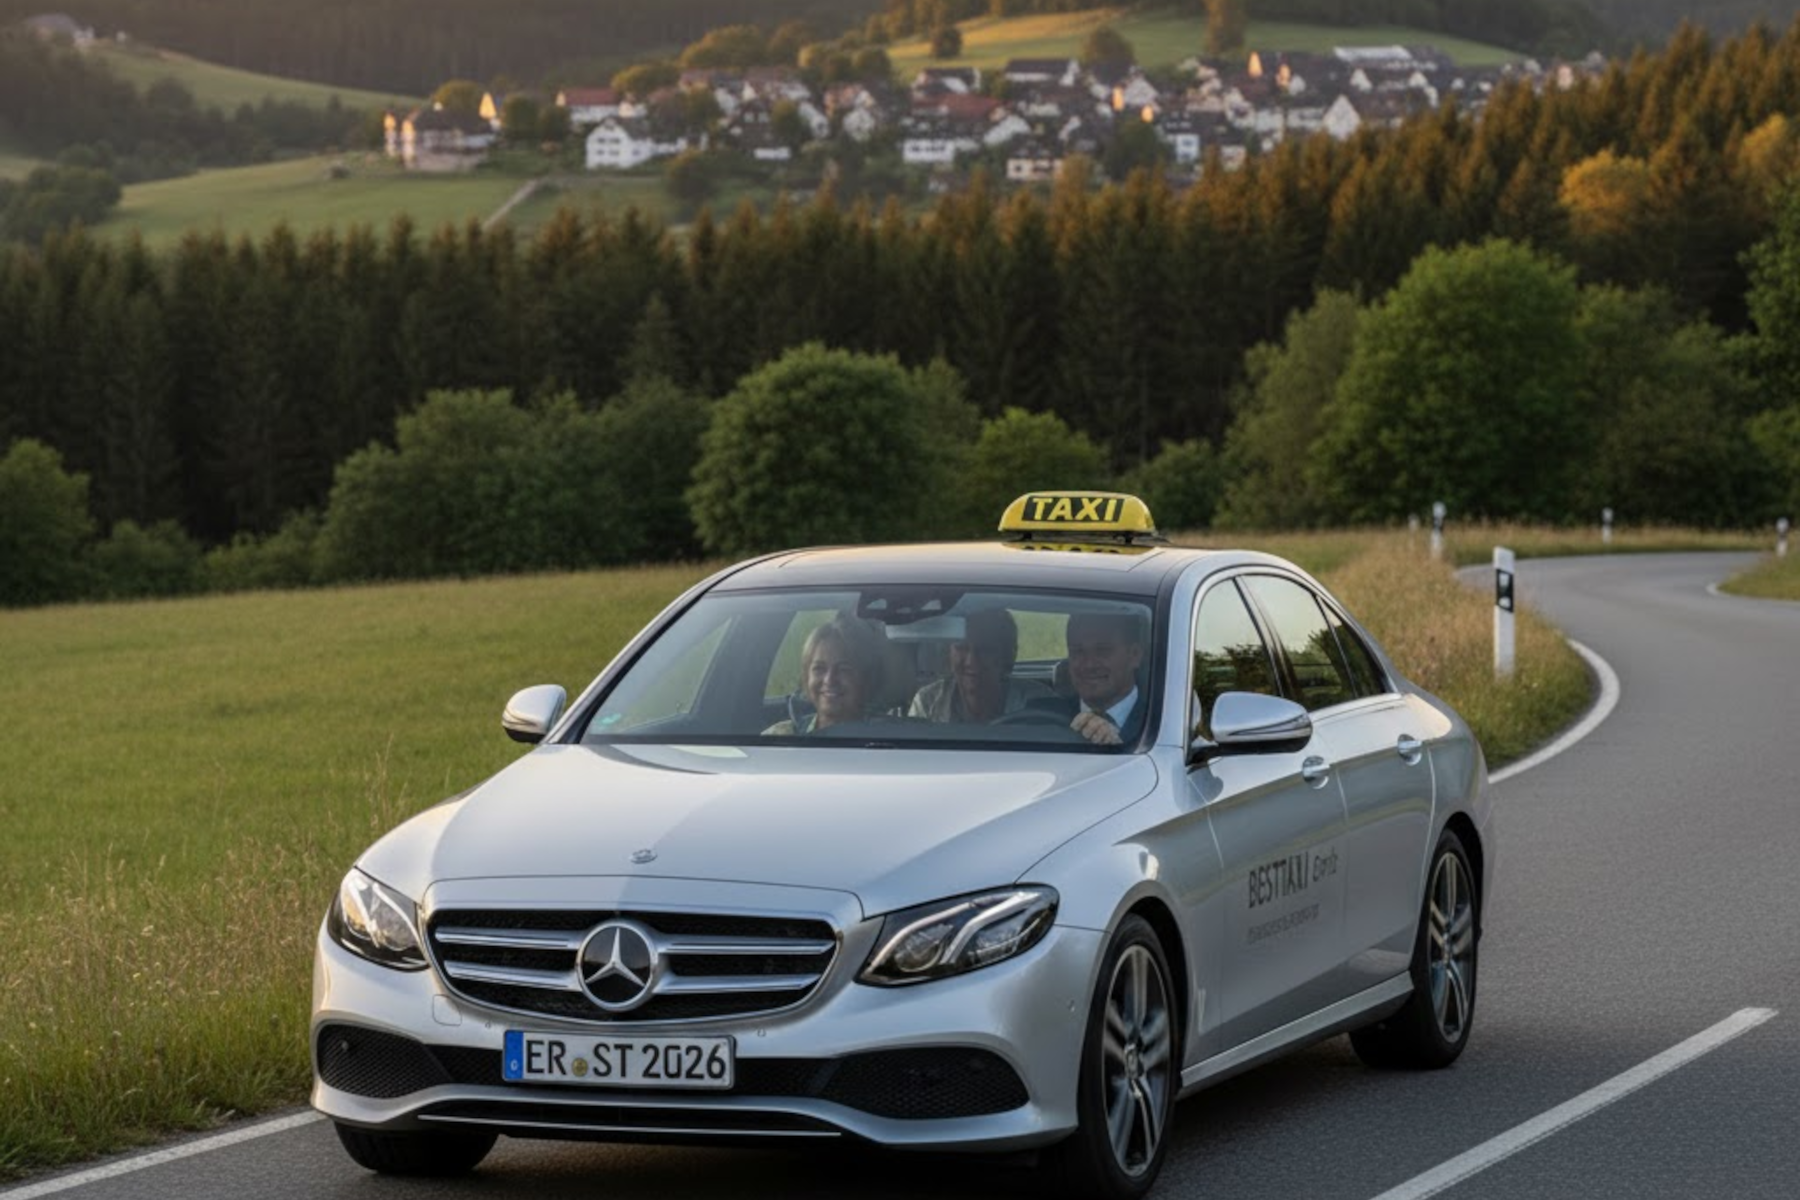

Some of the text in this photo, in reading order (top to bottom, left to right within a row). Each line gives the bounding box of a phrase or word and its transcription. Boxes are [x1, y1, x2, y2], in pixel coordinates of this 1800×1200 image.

[1032, 497, 1118, 521] TAXI
[525, 1039, 727, 1080] ER ST 2026
